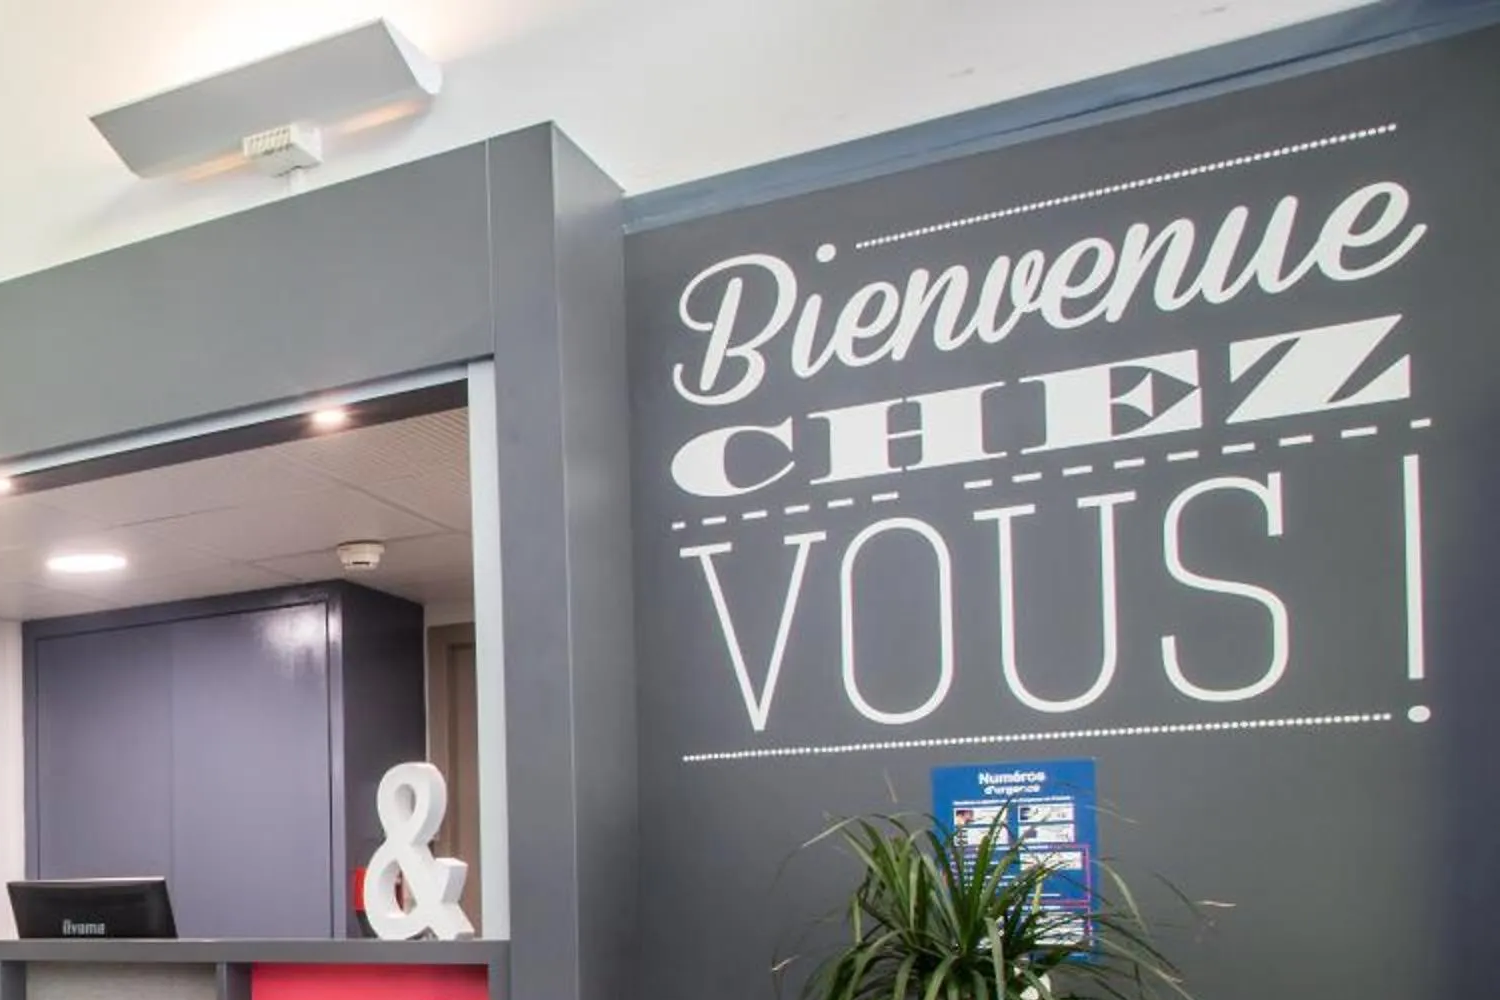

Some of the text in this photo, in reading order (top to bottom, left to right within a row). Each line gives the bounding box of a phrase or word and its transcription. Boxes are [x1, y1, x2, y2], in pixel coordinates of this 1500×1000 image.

[670, 313, 1411, 498] CHEZ
[672, 181, 1428, 406] Bienvenue
[679, 471, 1289, 733] VOUS
